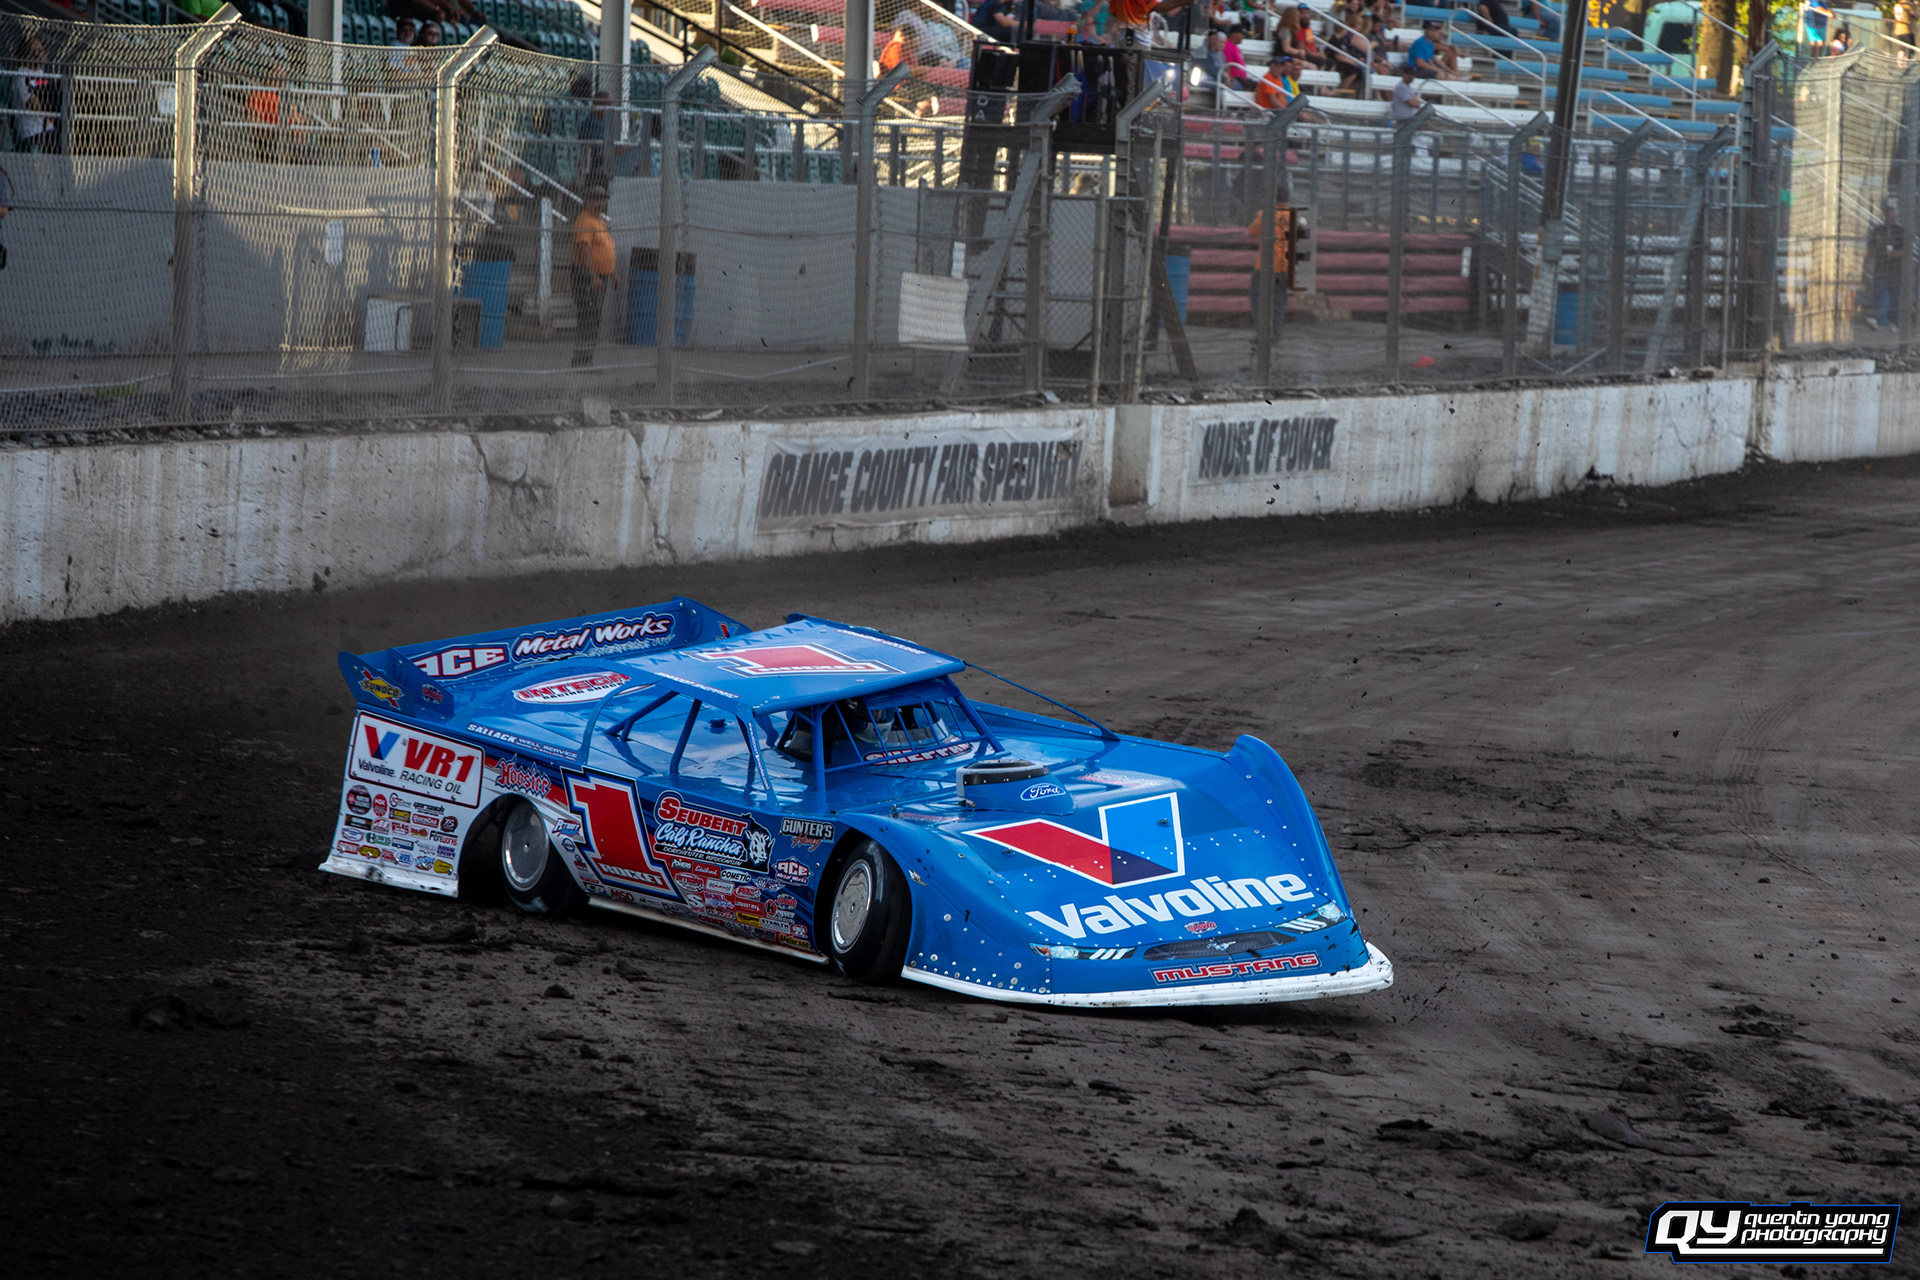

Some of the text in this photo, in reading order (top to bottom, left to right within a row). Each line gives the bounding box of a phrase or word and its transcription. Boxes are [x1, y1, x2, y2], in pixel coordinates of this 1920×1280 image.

[1198, 417, 1338, 478] HOUSE OF POWER
[760, 440, 1083, 519] ORANGE COUNTY FAIR SPEEDWAY
[413, 648, 506, 677] ACE
[515, 628, 591, 657] Metal
[595, 617, 671, 643] Works
[363, 681, 400, 698] SUNOCO
[467, 724, 579, 758] SALLACK WELL SERVICE
[404, 737, 475, 783] VR1
[400, 770, 463, 795] RACING OIL
[498, 762, 549, 794] Hoosier
[1030, 783, 1061, 798] Ford
[658, 797, 749, 837] SEUBERT
[782, 819, 832, 838] GUNTER'S
[572, 783, 671, 890] 1
[656, 823, 743, 856] Calf Ranches
[598, 862, 664, 885] ROCKET
[721, 870, 751, 882] COMETIC
[777, 861, 809, 877] ACE
[610, 887, 635, 902] MSD
[1025, 872, 1314, 940] Valvoline
[1155, 953, 1319, 983] MUSTANG
